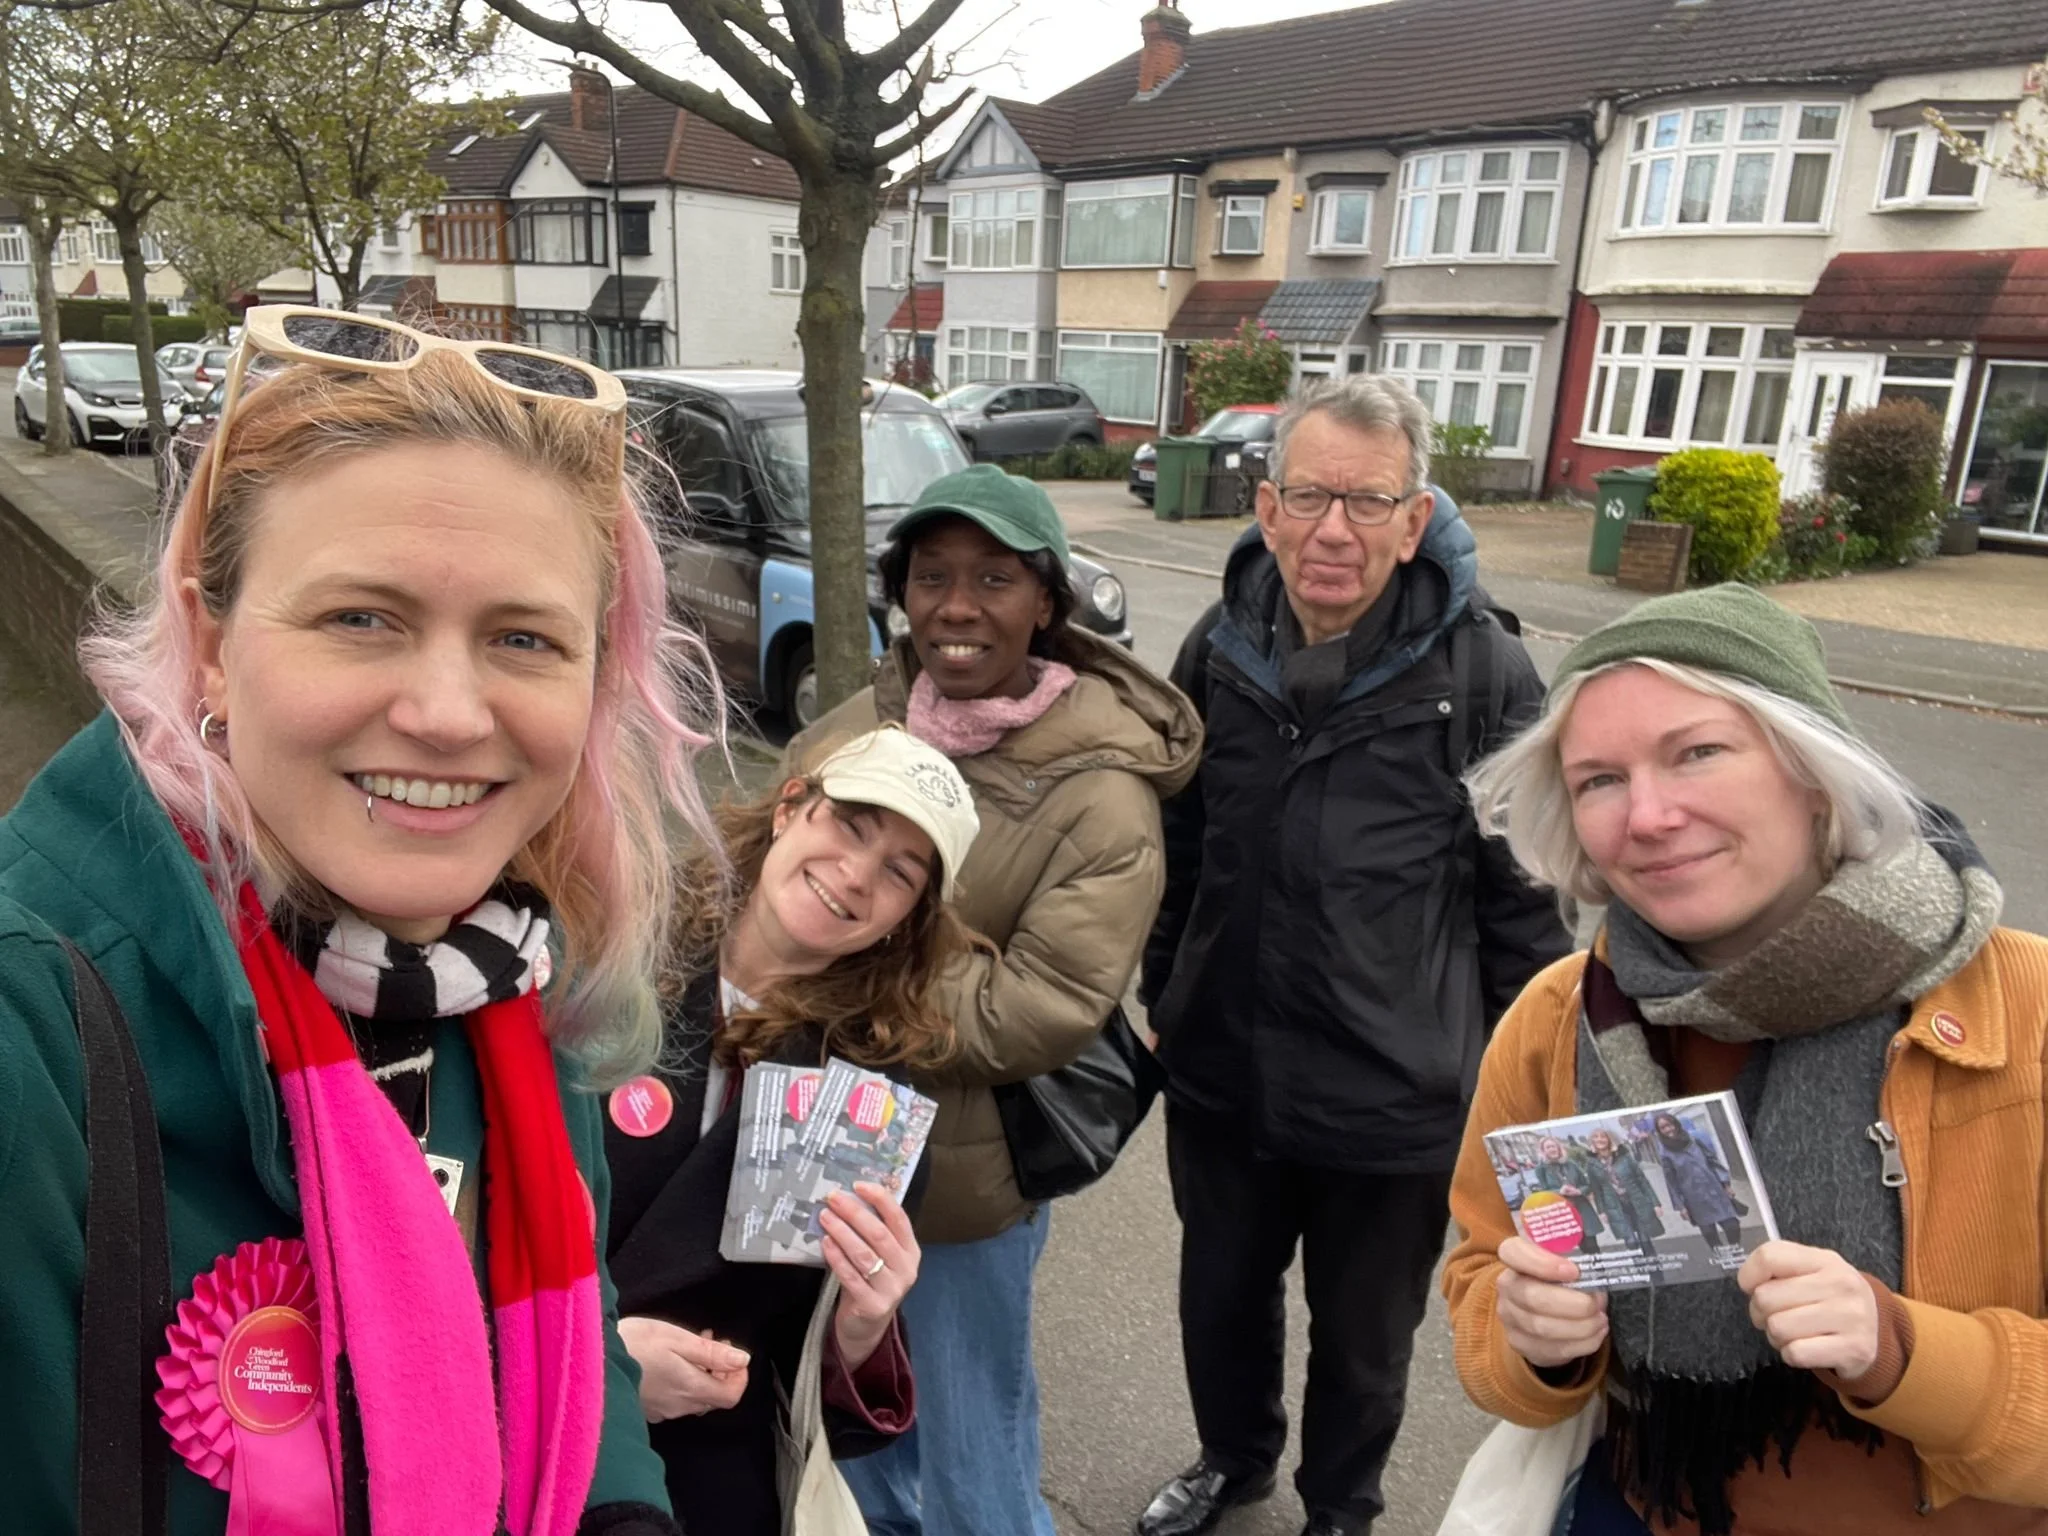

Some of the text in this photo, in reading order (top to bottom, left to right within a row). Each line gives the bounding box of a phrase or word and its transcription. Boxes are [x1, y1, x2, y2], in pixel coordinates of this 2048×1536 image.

[255, 1357, 288, 1367] Woodford
[234, 1366, 293, 1380] Community
[248, 1380, 312, 1394] Independents
